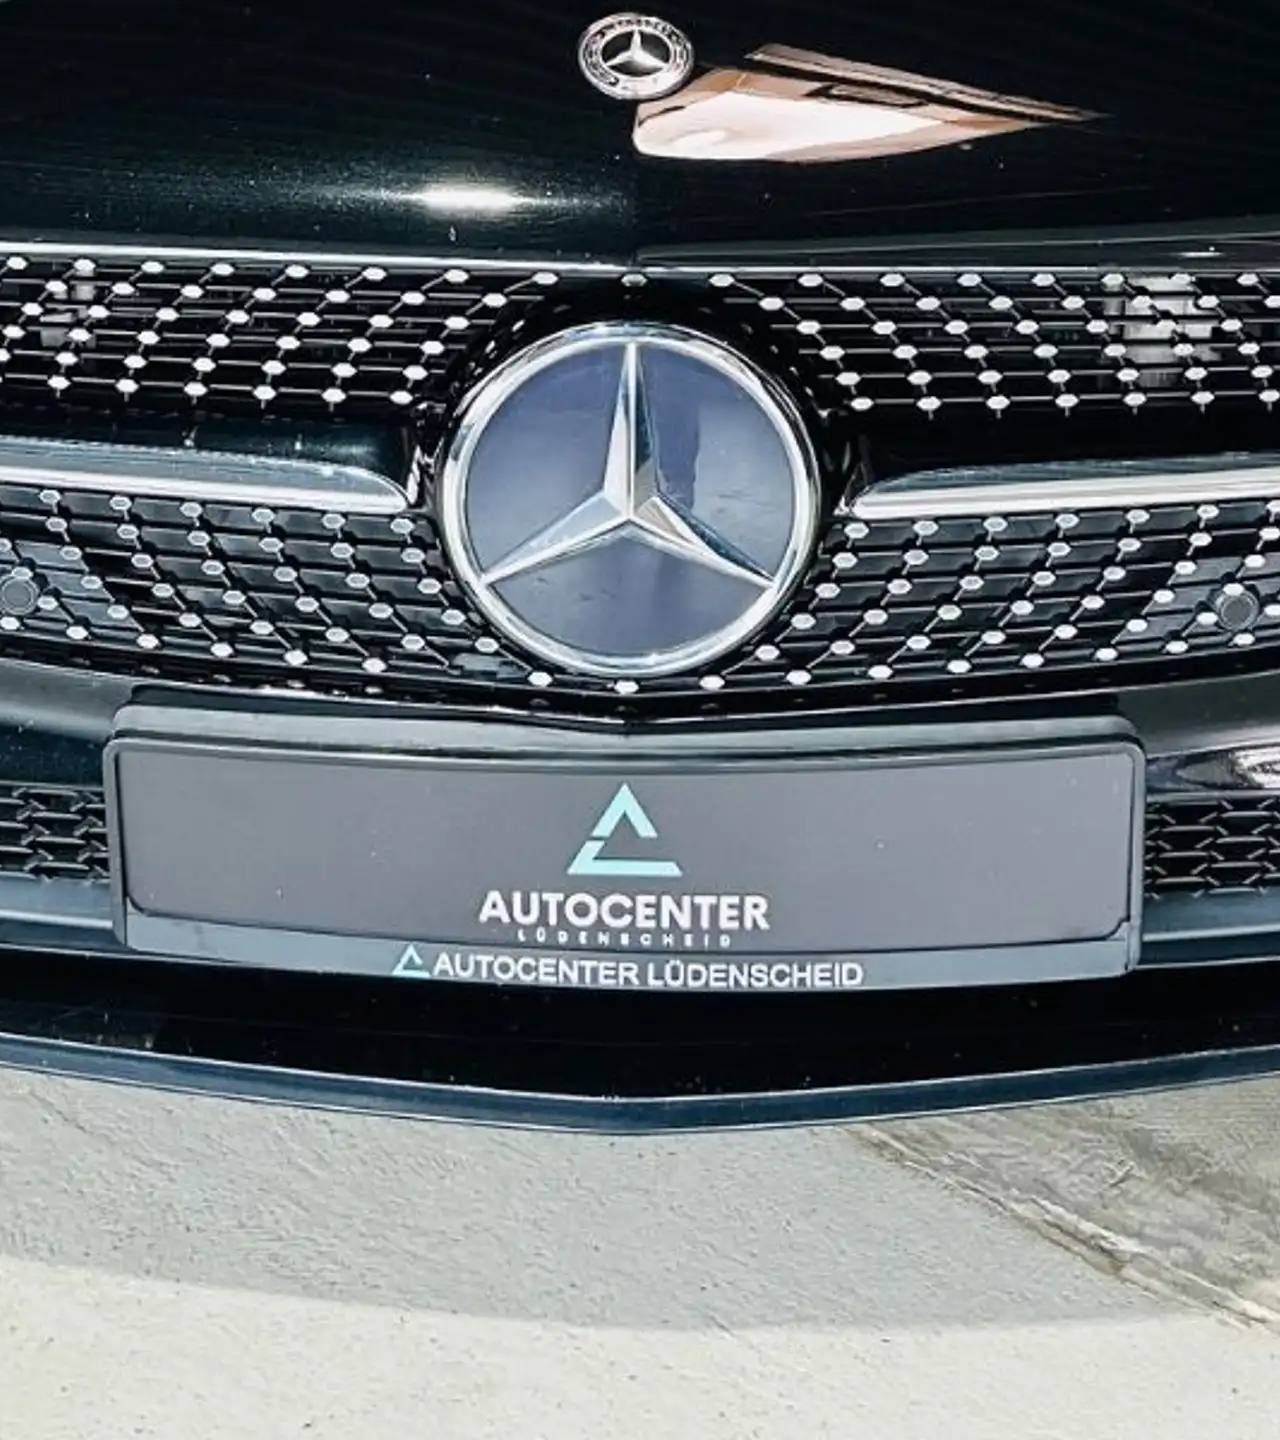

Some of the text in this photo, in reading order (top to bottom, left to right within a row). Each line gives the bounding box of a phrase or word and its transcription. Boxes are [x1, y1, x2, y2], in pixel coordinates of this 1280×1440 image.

[478, 889, 770, 931] AUTOCENTER
[517, 926, 731, 948] LÜDENSCHEID
[433, 951, 864, 988] AUTOCENTER LÜDENSCHEID
